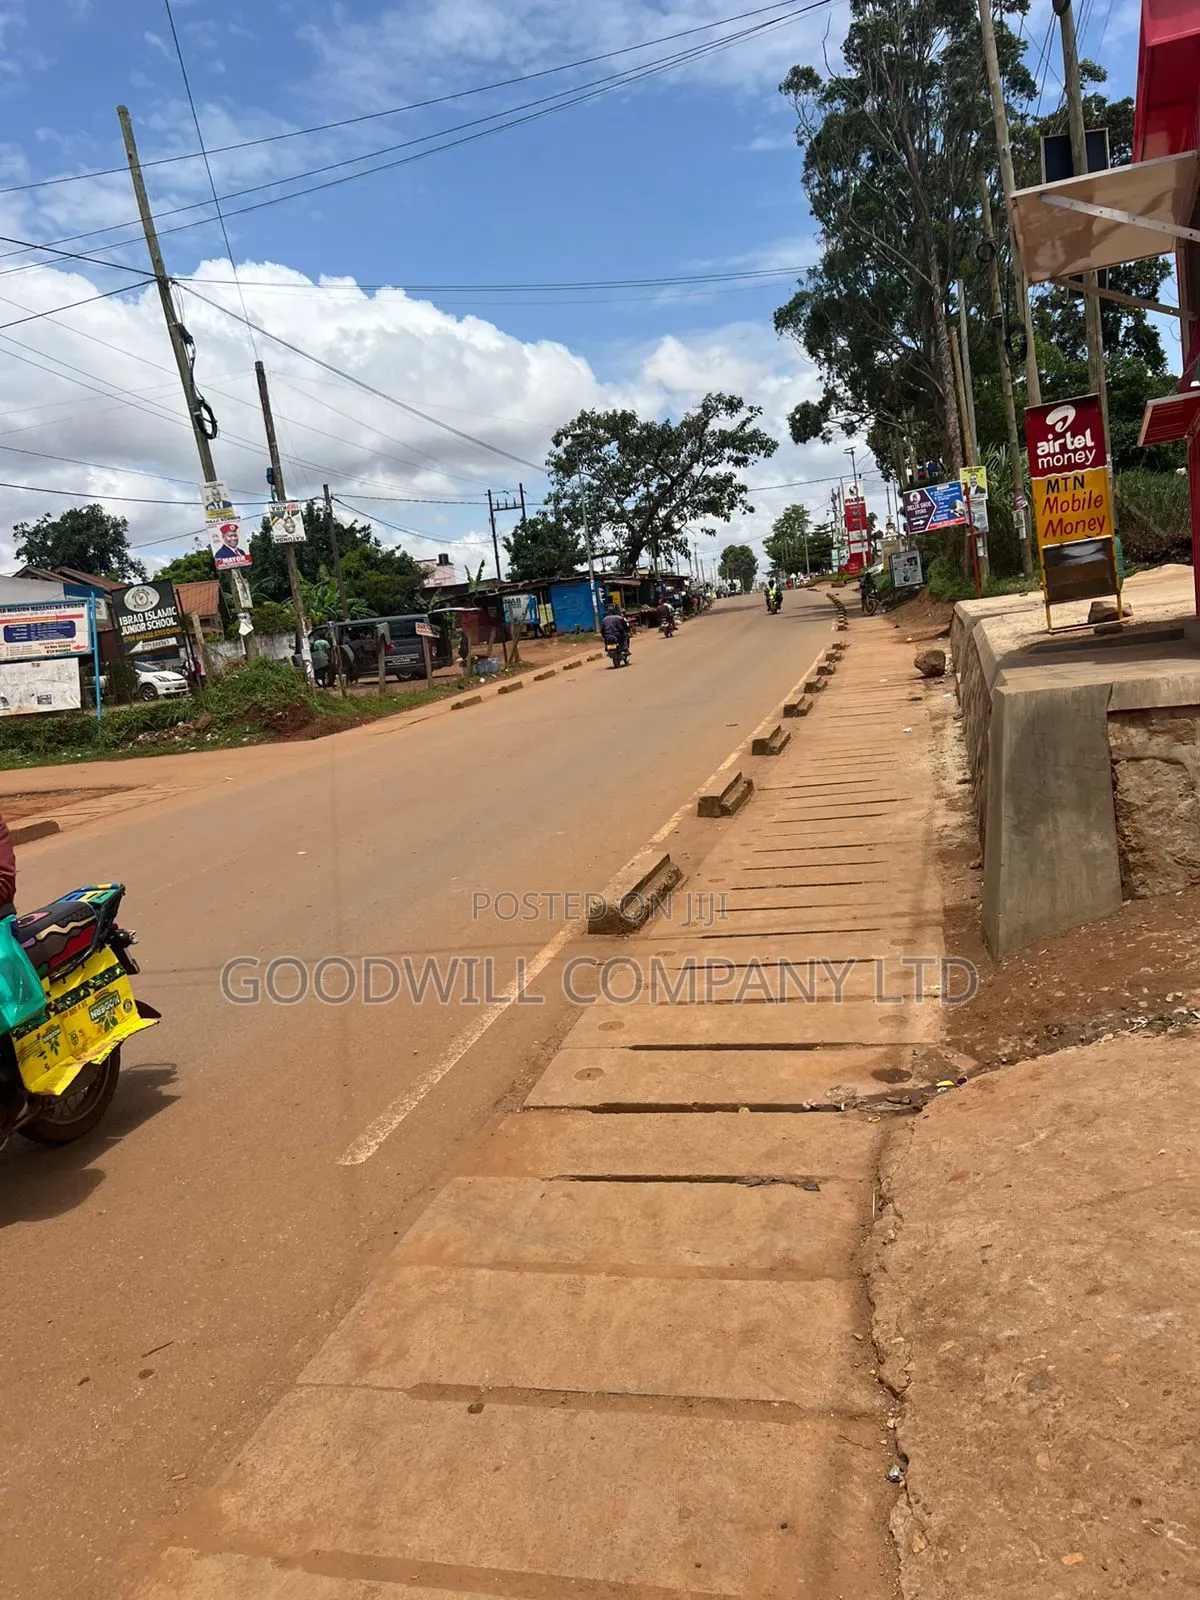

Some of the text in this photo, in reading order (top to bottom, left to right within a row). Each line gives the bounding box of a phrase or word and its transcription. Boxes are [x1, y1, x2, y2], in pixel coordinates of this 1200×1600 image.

[1037, 428, 1095, 456] airtel
[1038, 449, 1096, 469] money
[1046, 474, 1085, 495] MTN
[1042, 490, 1103, 516] Mobile
[1043, 515, 1106, 539] Money
[119, 607, 177, 626] IBRAQ ISLAMIC
[121, 622, 147, 636] JUNIOR
[146, 617, 177, 631] SCHOOL
[90, 995, 121, 1020] MODERN
